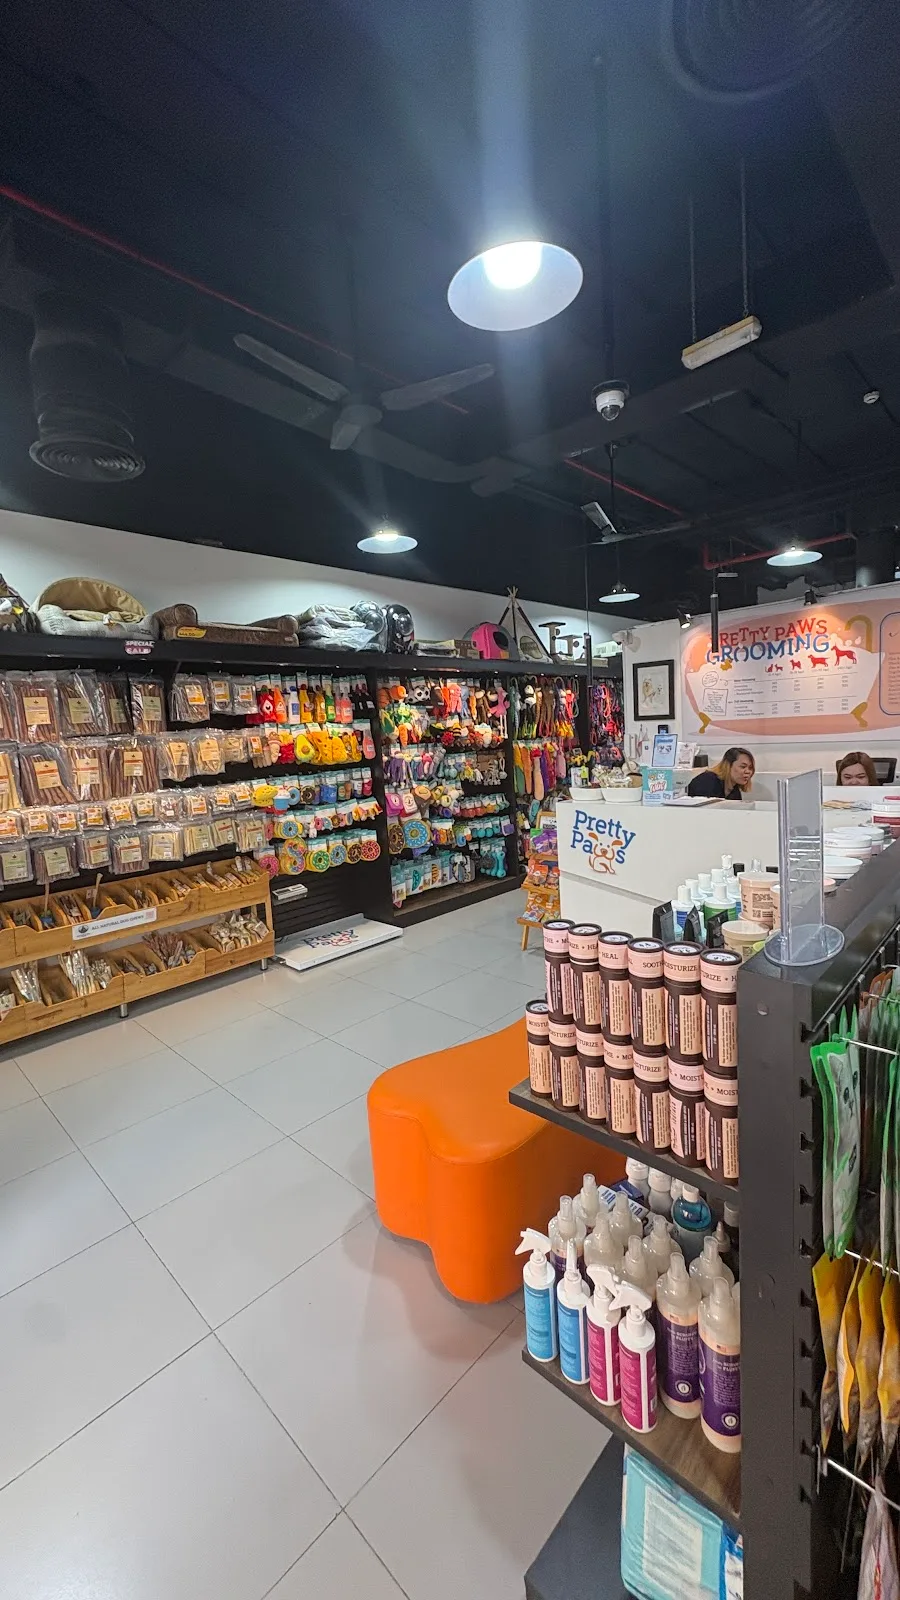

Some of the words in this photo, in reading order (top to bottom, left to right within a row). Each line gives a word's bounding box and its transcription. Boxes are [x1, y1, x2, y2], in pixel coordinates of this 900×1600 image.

[710, 626, 770, 648] RETTY
[775, 617, 827, 642] PAWS
[125, 640, 154, 648] SPECIAL
[707, 633, 829, 665] GROOMING
[573, 809, 636, 849] Pretty
[100, 920, 119, 929] NATURAL
[601, 952, 618, 960] HEAL
